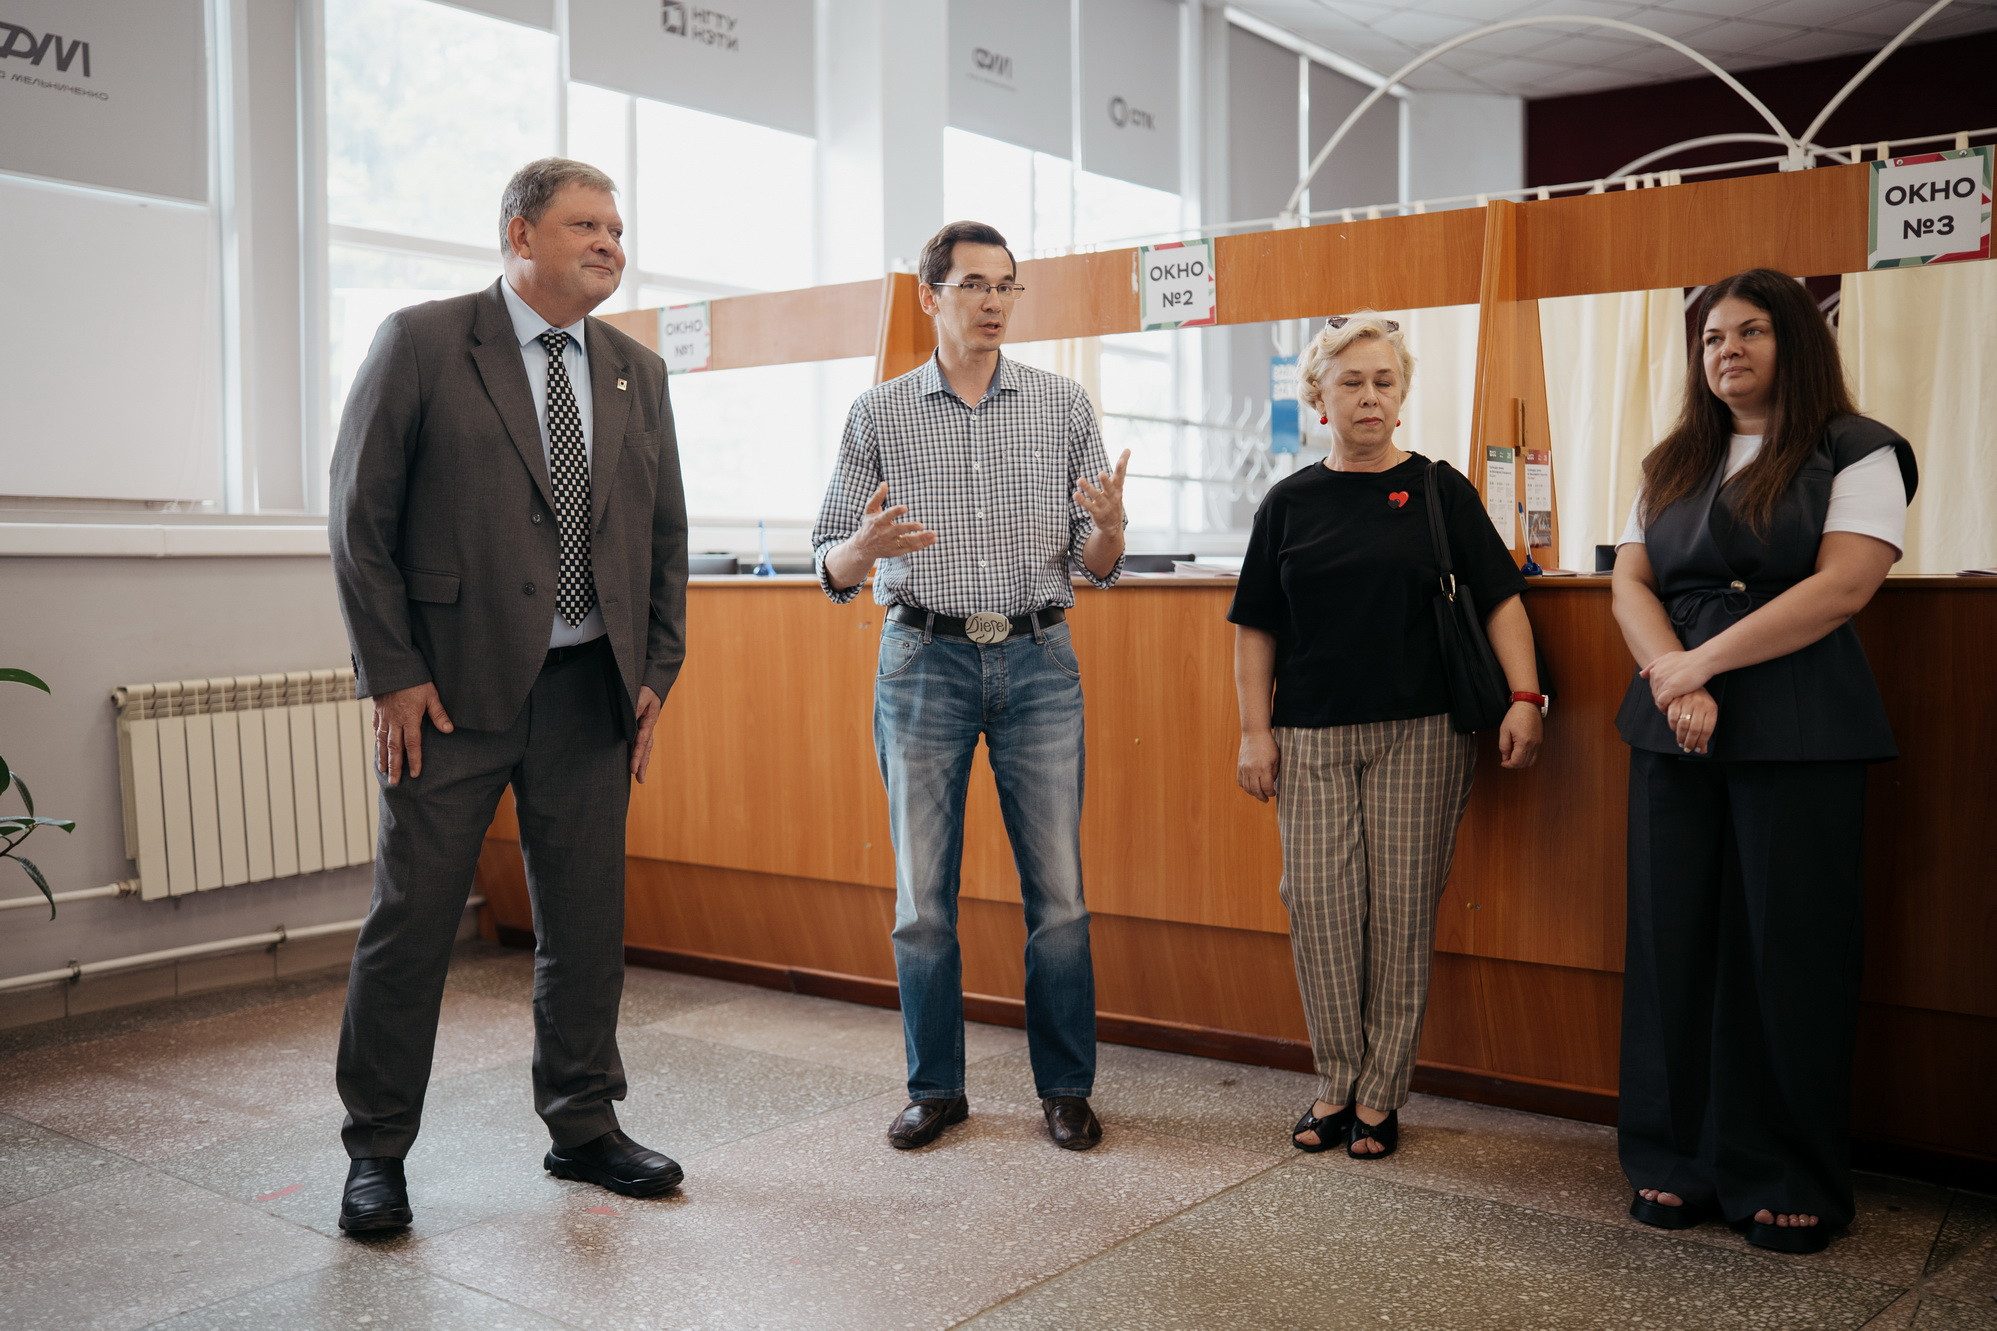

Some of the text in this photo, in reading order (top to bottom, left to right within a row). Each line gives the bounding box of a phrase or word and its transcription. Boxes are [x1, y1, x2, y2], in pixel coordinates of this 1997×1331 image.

[691, 6, 738, 31] НГТУ
[691, 25, 739, 51] НЭТИ
[1885, 177, 1976, 206] ОКНО
[1903, 215, 1955, 239] №3
[1150, 260, 1204, 282] ОКНО
[1162, 289, 1194, 308] №2
[665, 319, 703, 336] ОКНО
[966, 616, 1008, 643] Diesel
